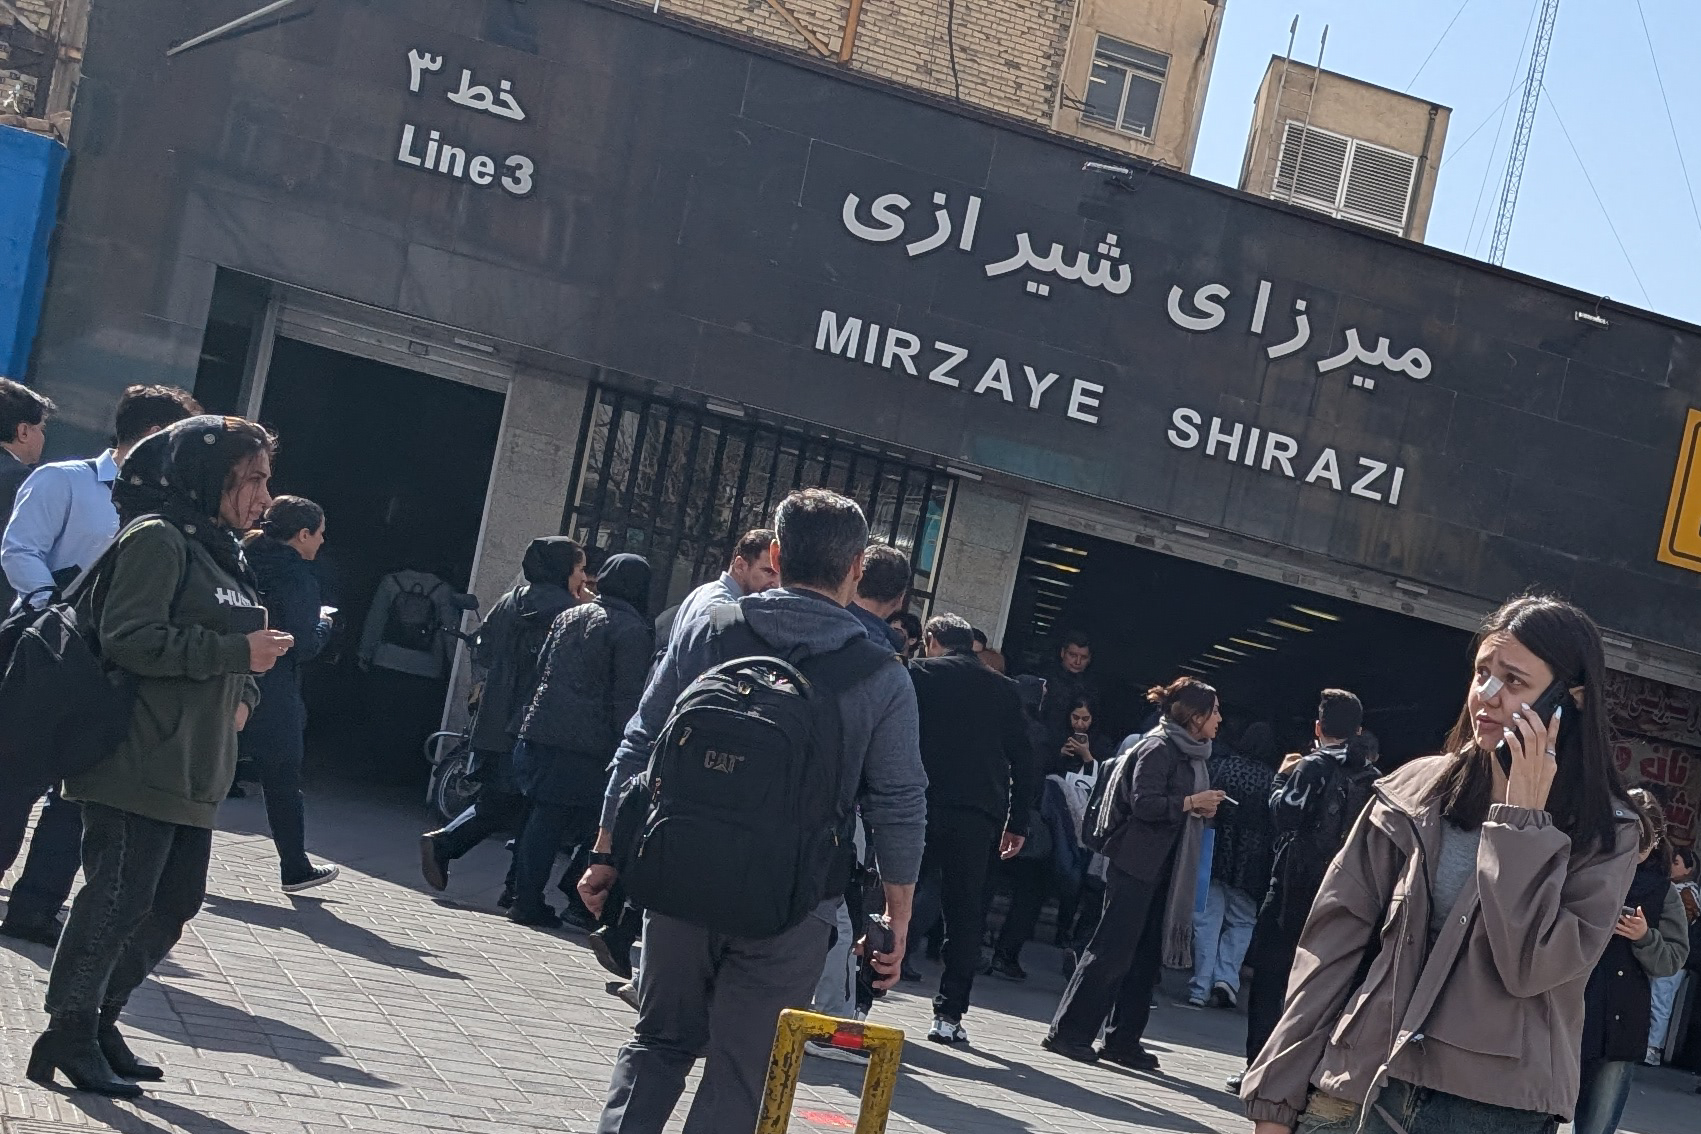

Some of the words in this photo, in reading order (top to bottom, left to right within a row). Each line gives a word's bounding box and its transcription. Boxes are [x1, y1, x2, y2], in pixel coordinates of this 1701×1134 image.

[408, 49, 442, 92] ۳
[448, 69, 525, 120] خط
[843, 192, 1131, 296] شیرازی
[1168, 280, 1431, 389] میرزای
[816, 310, 1103, 423] MIRZAYE
[1168, 408, 1404, 504] SHIRAZI
[704, 751, 737, 774] CAT
[1640, 744, 1690, 787] نان
